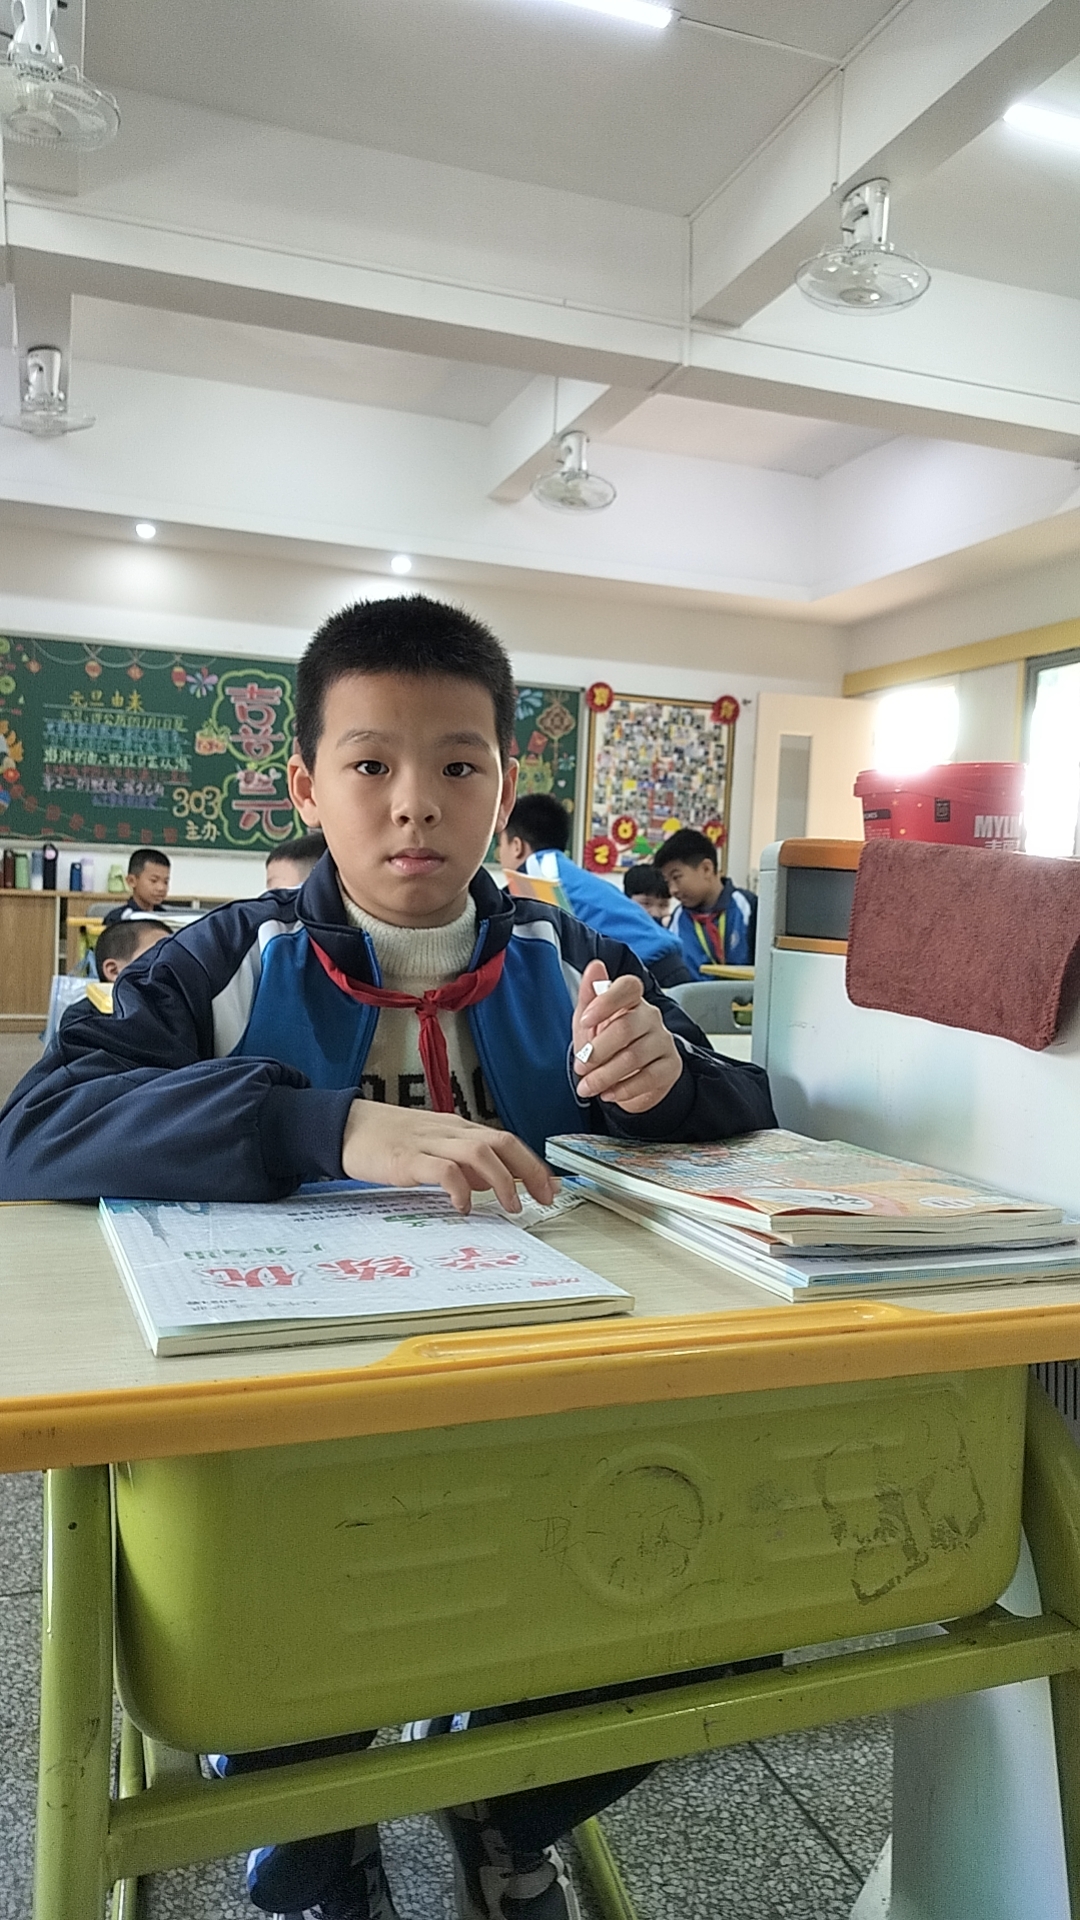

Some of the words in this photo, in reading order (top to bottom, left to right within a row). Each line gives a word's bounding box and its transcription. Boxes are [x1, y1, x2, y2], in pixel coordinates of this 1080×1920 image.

[69, 689, 145, 713] 元旦由来
[172, 786, 222, 820] 303
[184, 819, 221, 842] 主办
[201, 1246, 521, 1288] 学练优
